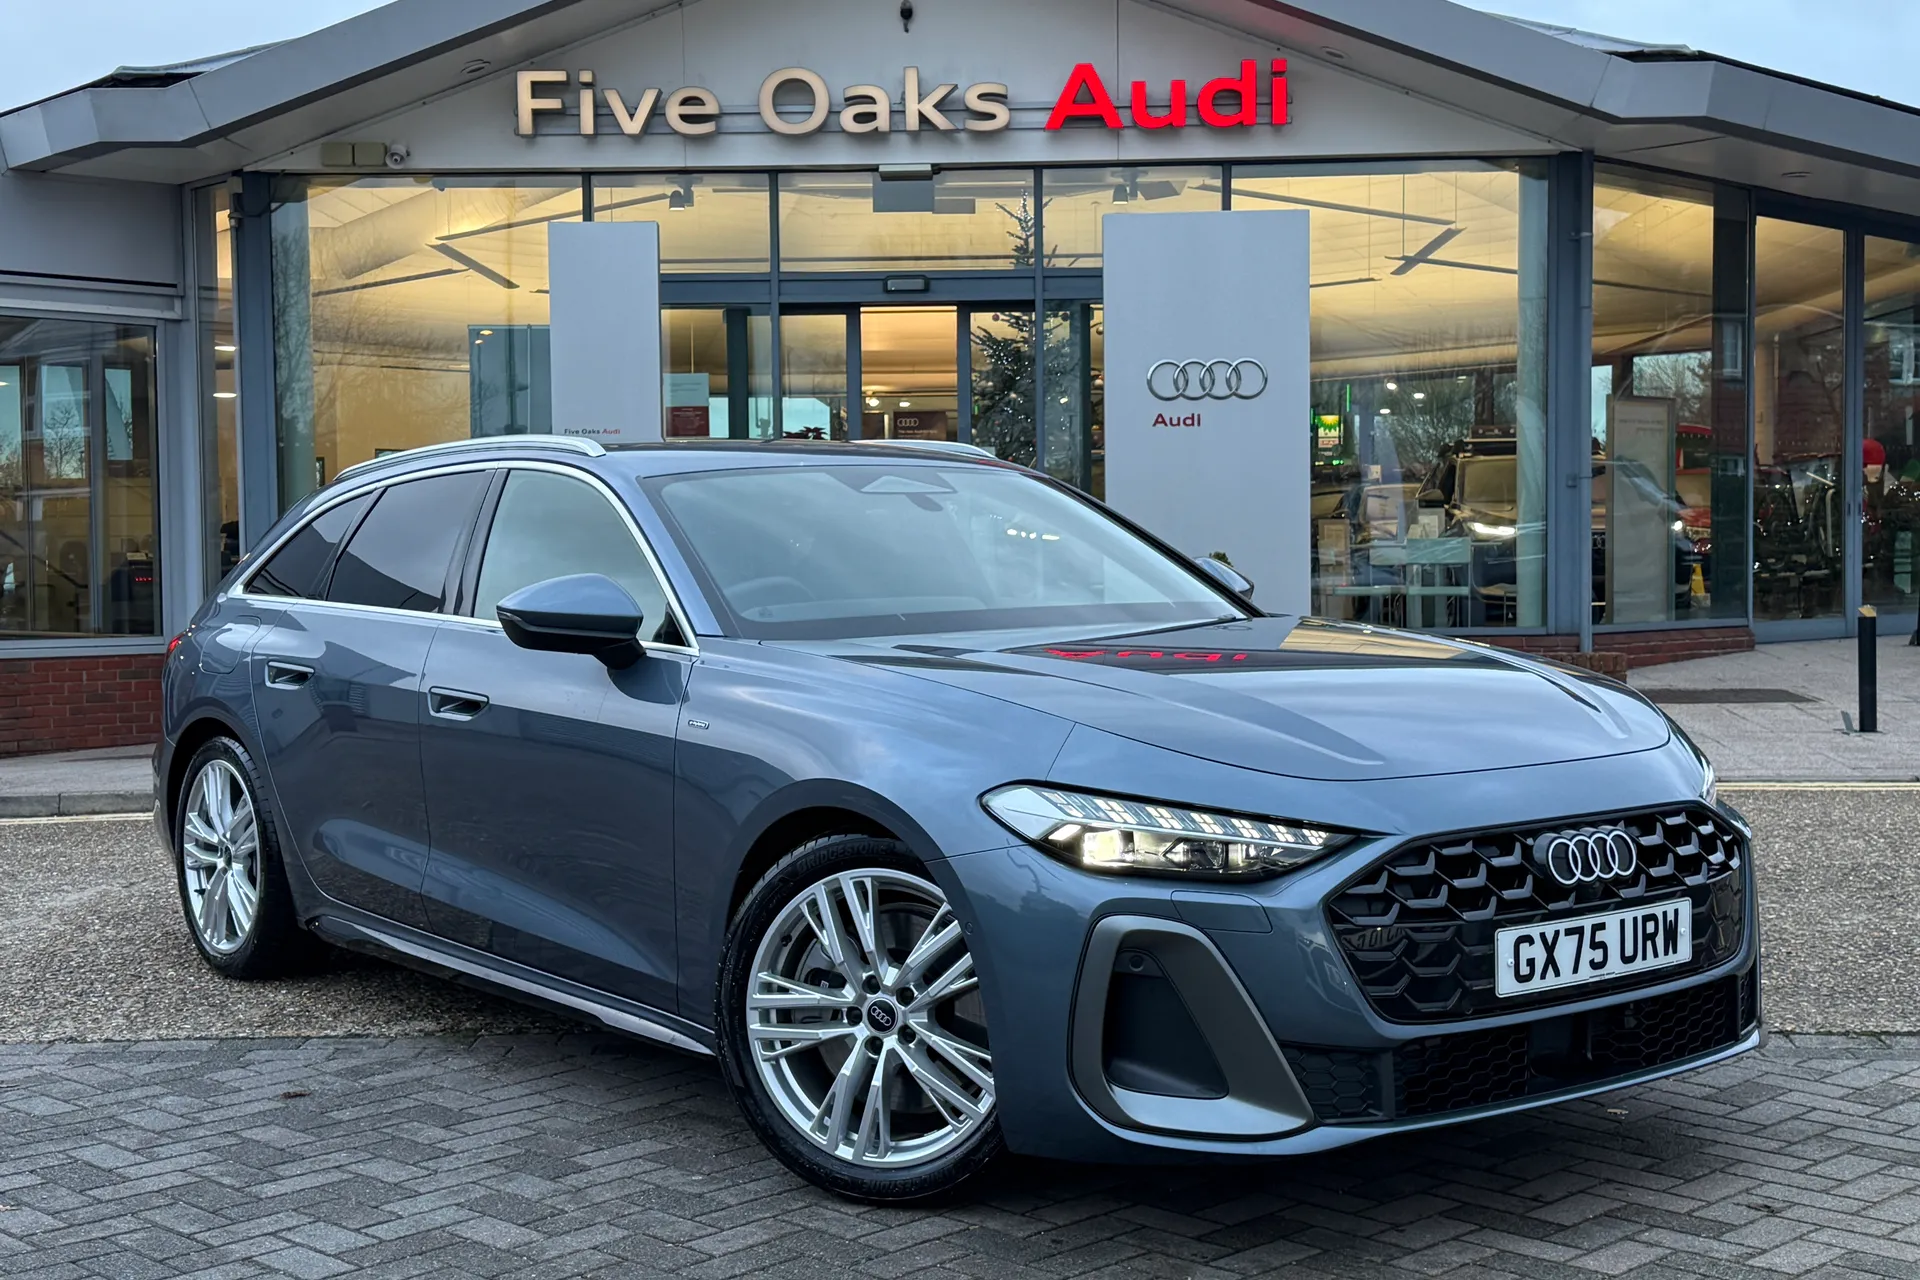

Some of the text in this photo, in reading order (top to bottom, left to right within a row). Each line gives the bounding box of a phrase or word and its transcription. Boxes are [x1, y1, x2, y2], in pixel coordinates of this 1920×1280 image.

[516, 59, 1287, 136] Five Oaks Audi
[1152, 413, 1201, 427] Audi
[1513, 908, 1680, 984] GX75 URW
